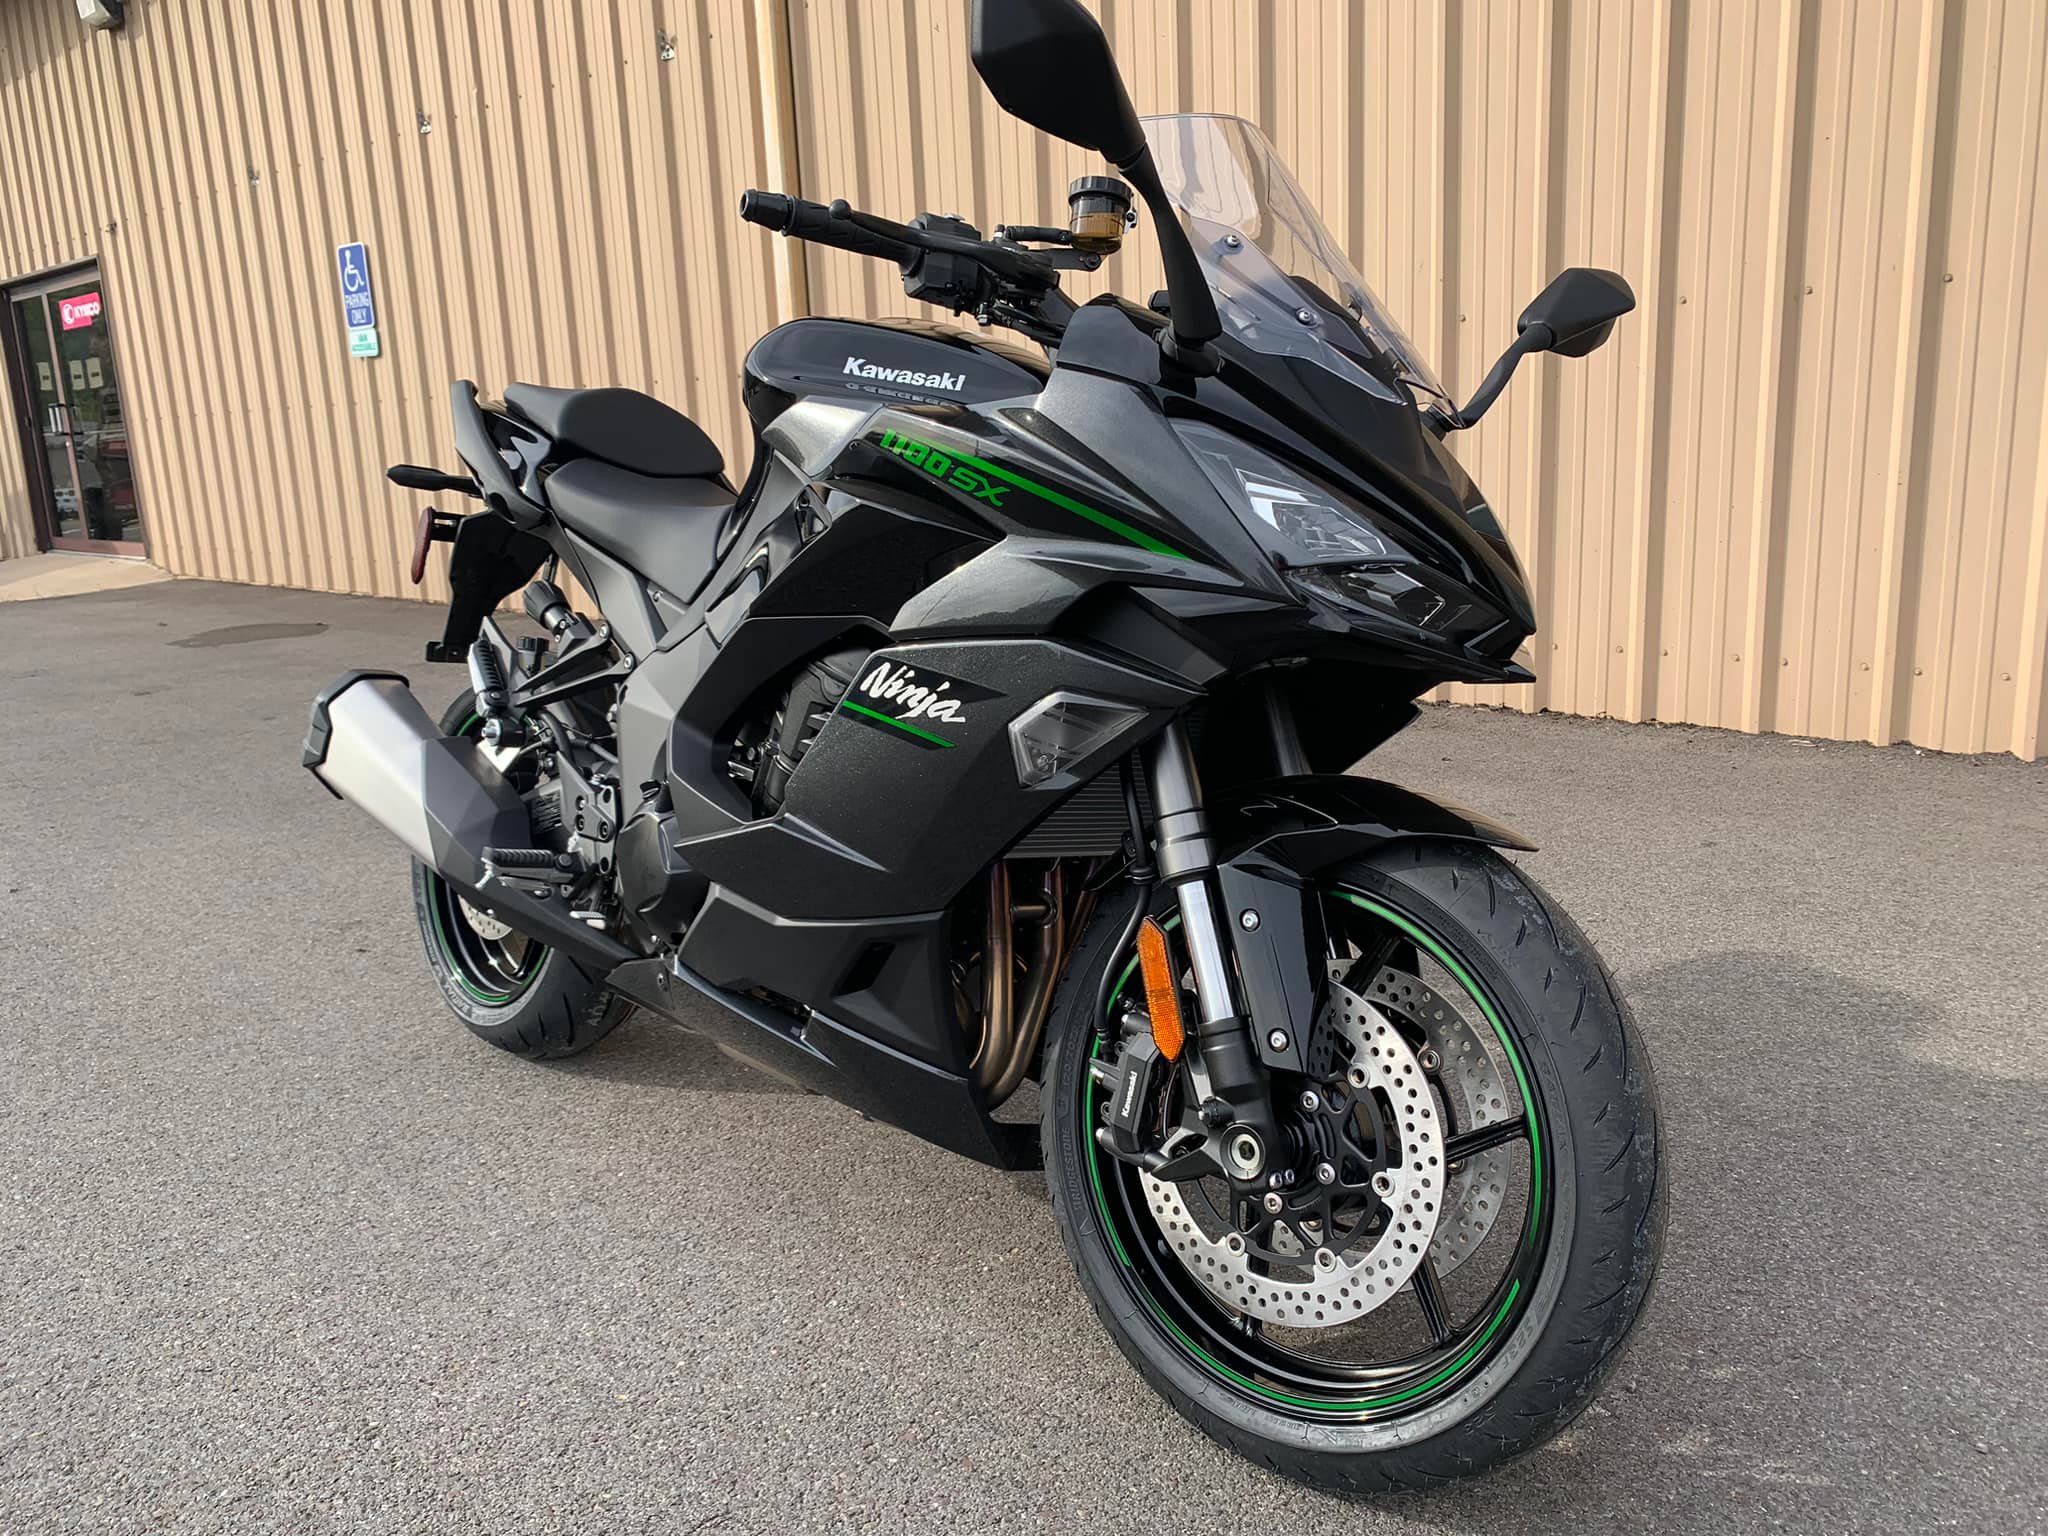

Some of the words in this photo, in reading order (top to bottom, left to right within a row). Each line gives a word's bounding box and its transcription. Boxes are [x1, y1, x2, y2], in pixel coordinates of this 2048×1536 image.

[843, 356, 966, 391] Kawasaki
[860, 662, 966, 723] Ninja
[1121, 1071, 1138, 1118] Kawasaki
